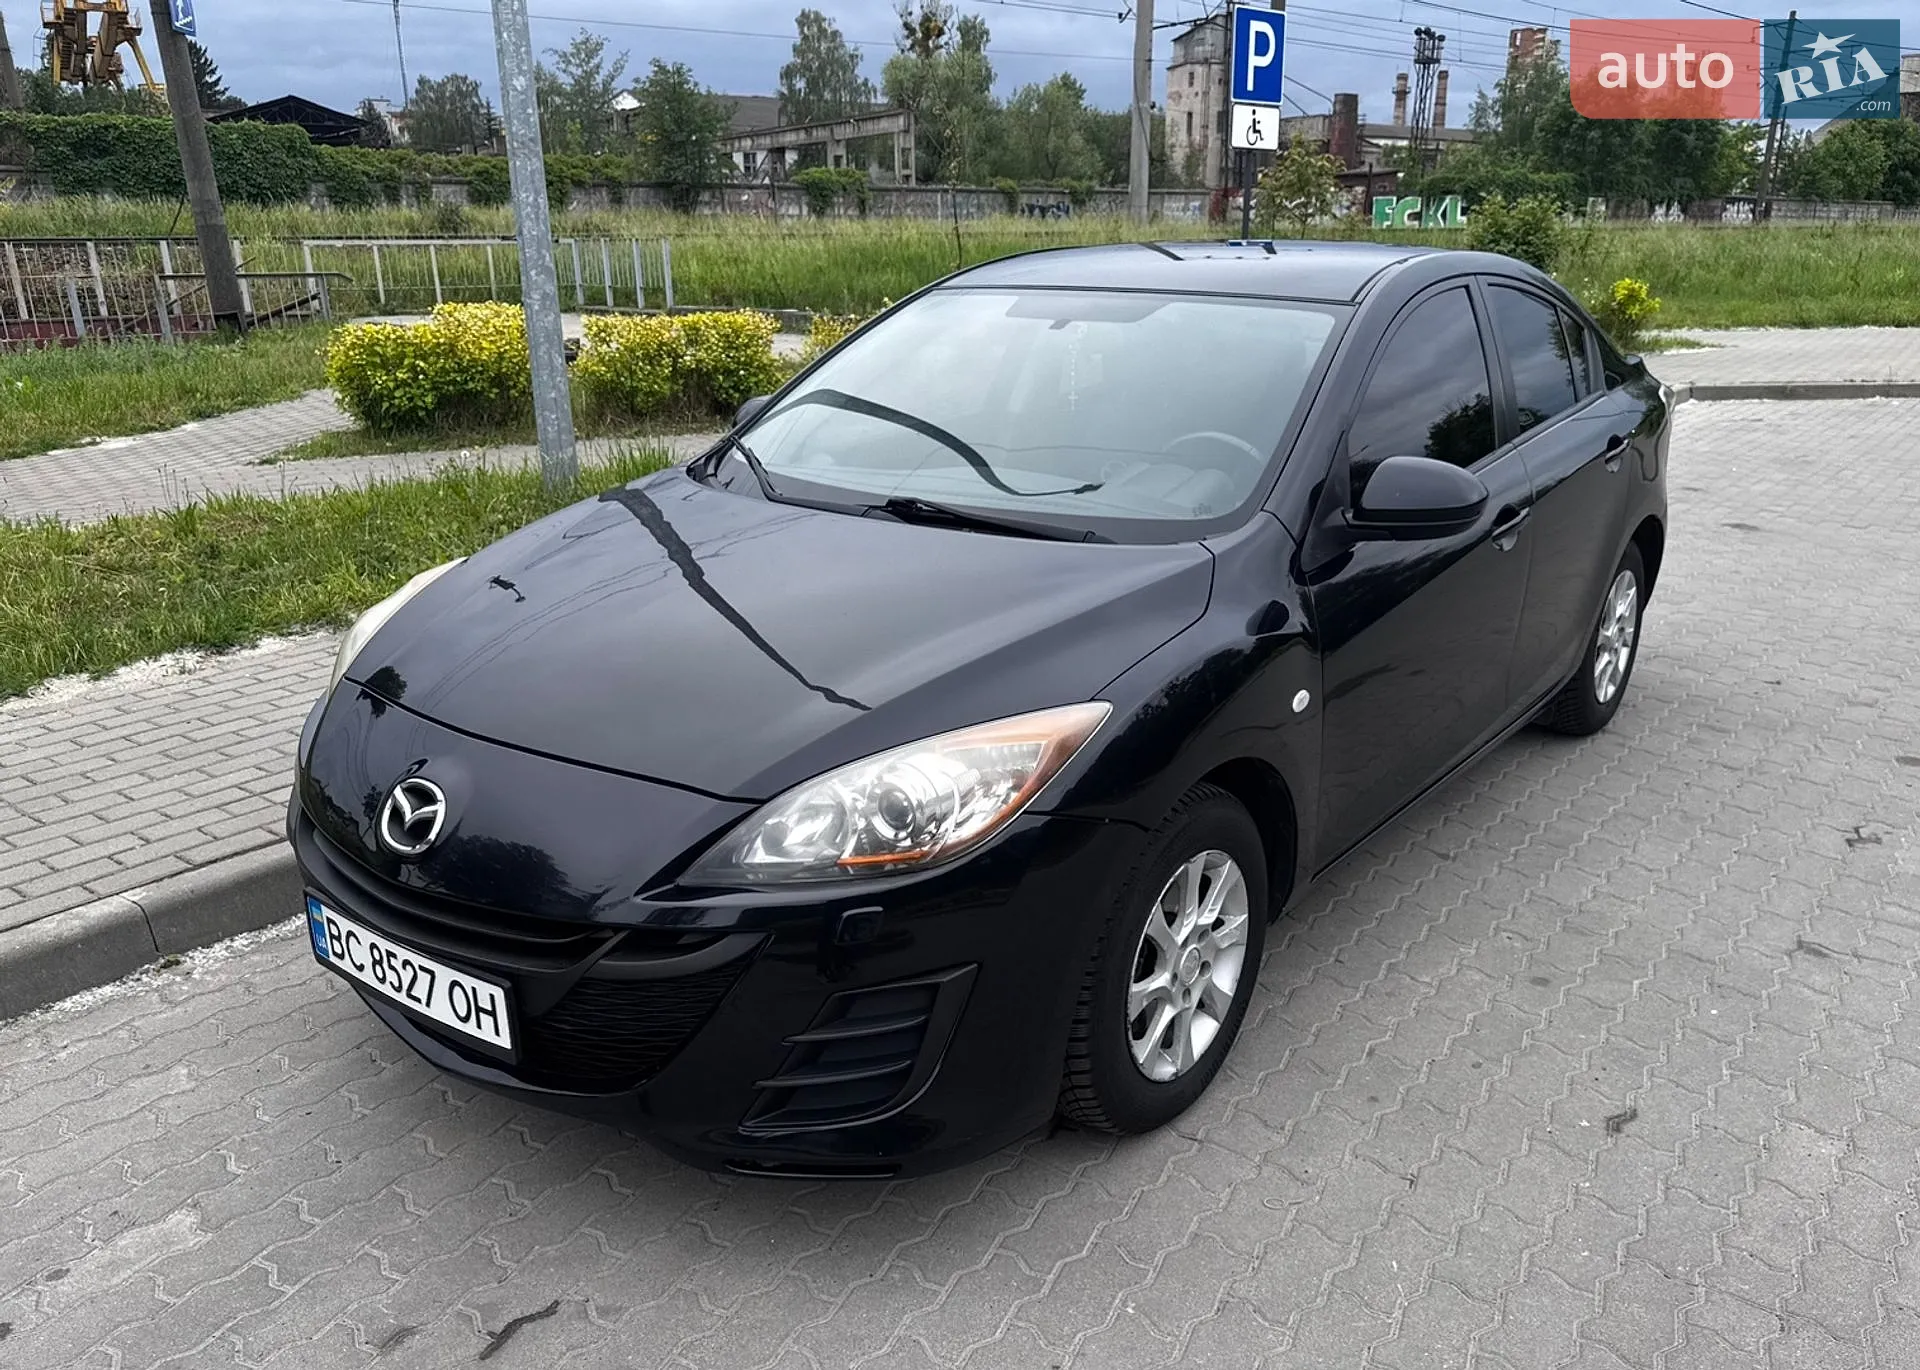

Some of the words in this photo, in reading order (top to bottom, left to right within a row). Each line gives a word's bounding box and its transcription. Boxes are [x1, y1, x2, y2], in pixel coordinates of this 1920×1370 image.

[1247, 20, 1276, 92] P
[315, 933, 327, 949] UA
[326, 916, 365, 972] BC
[369, 942, 436, 1008] 8527
[449, 980, 501, 1037] OH
